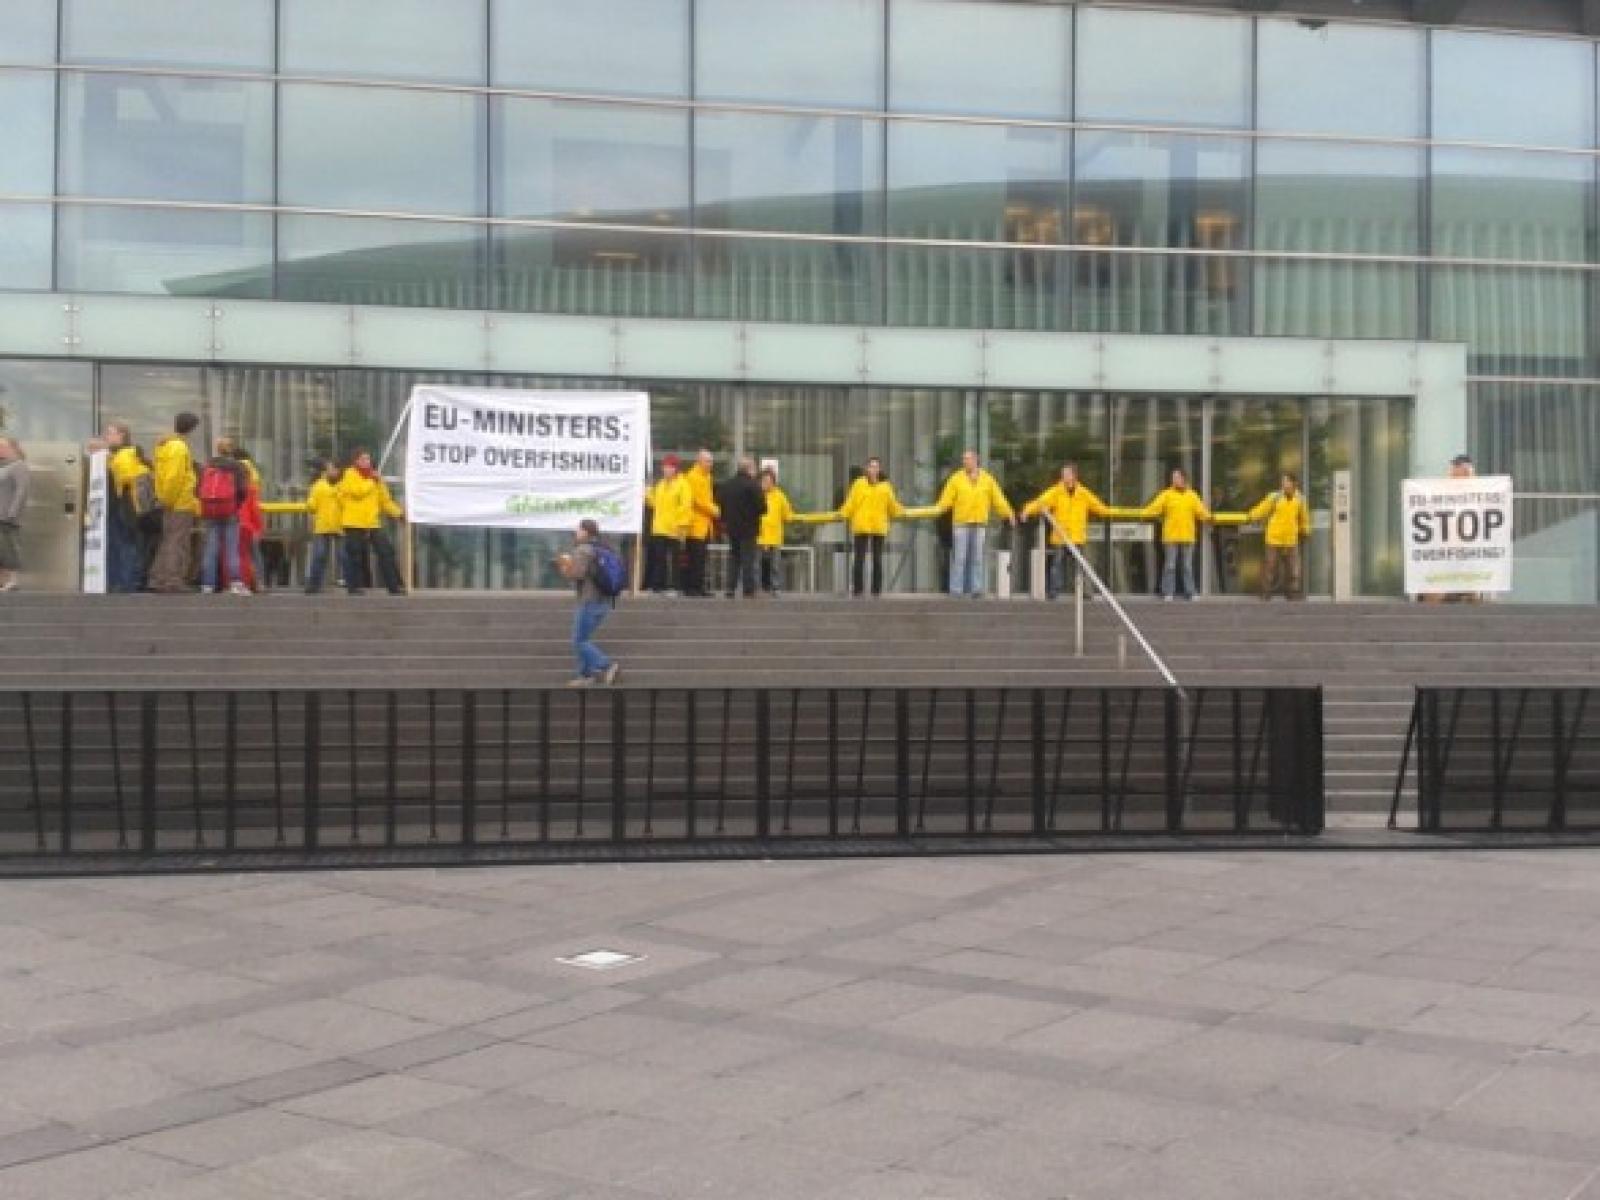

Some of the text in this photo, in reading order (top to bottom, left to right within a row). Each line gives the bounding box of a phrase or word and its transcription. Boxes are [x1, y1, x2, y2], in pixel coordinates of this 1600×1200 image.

[423, 404, 630, 441] EU-MINISTERS:
[422, 443, 630, 474] STOP OVERFISHING!
[1412, 509, 1504, 543] STOP
